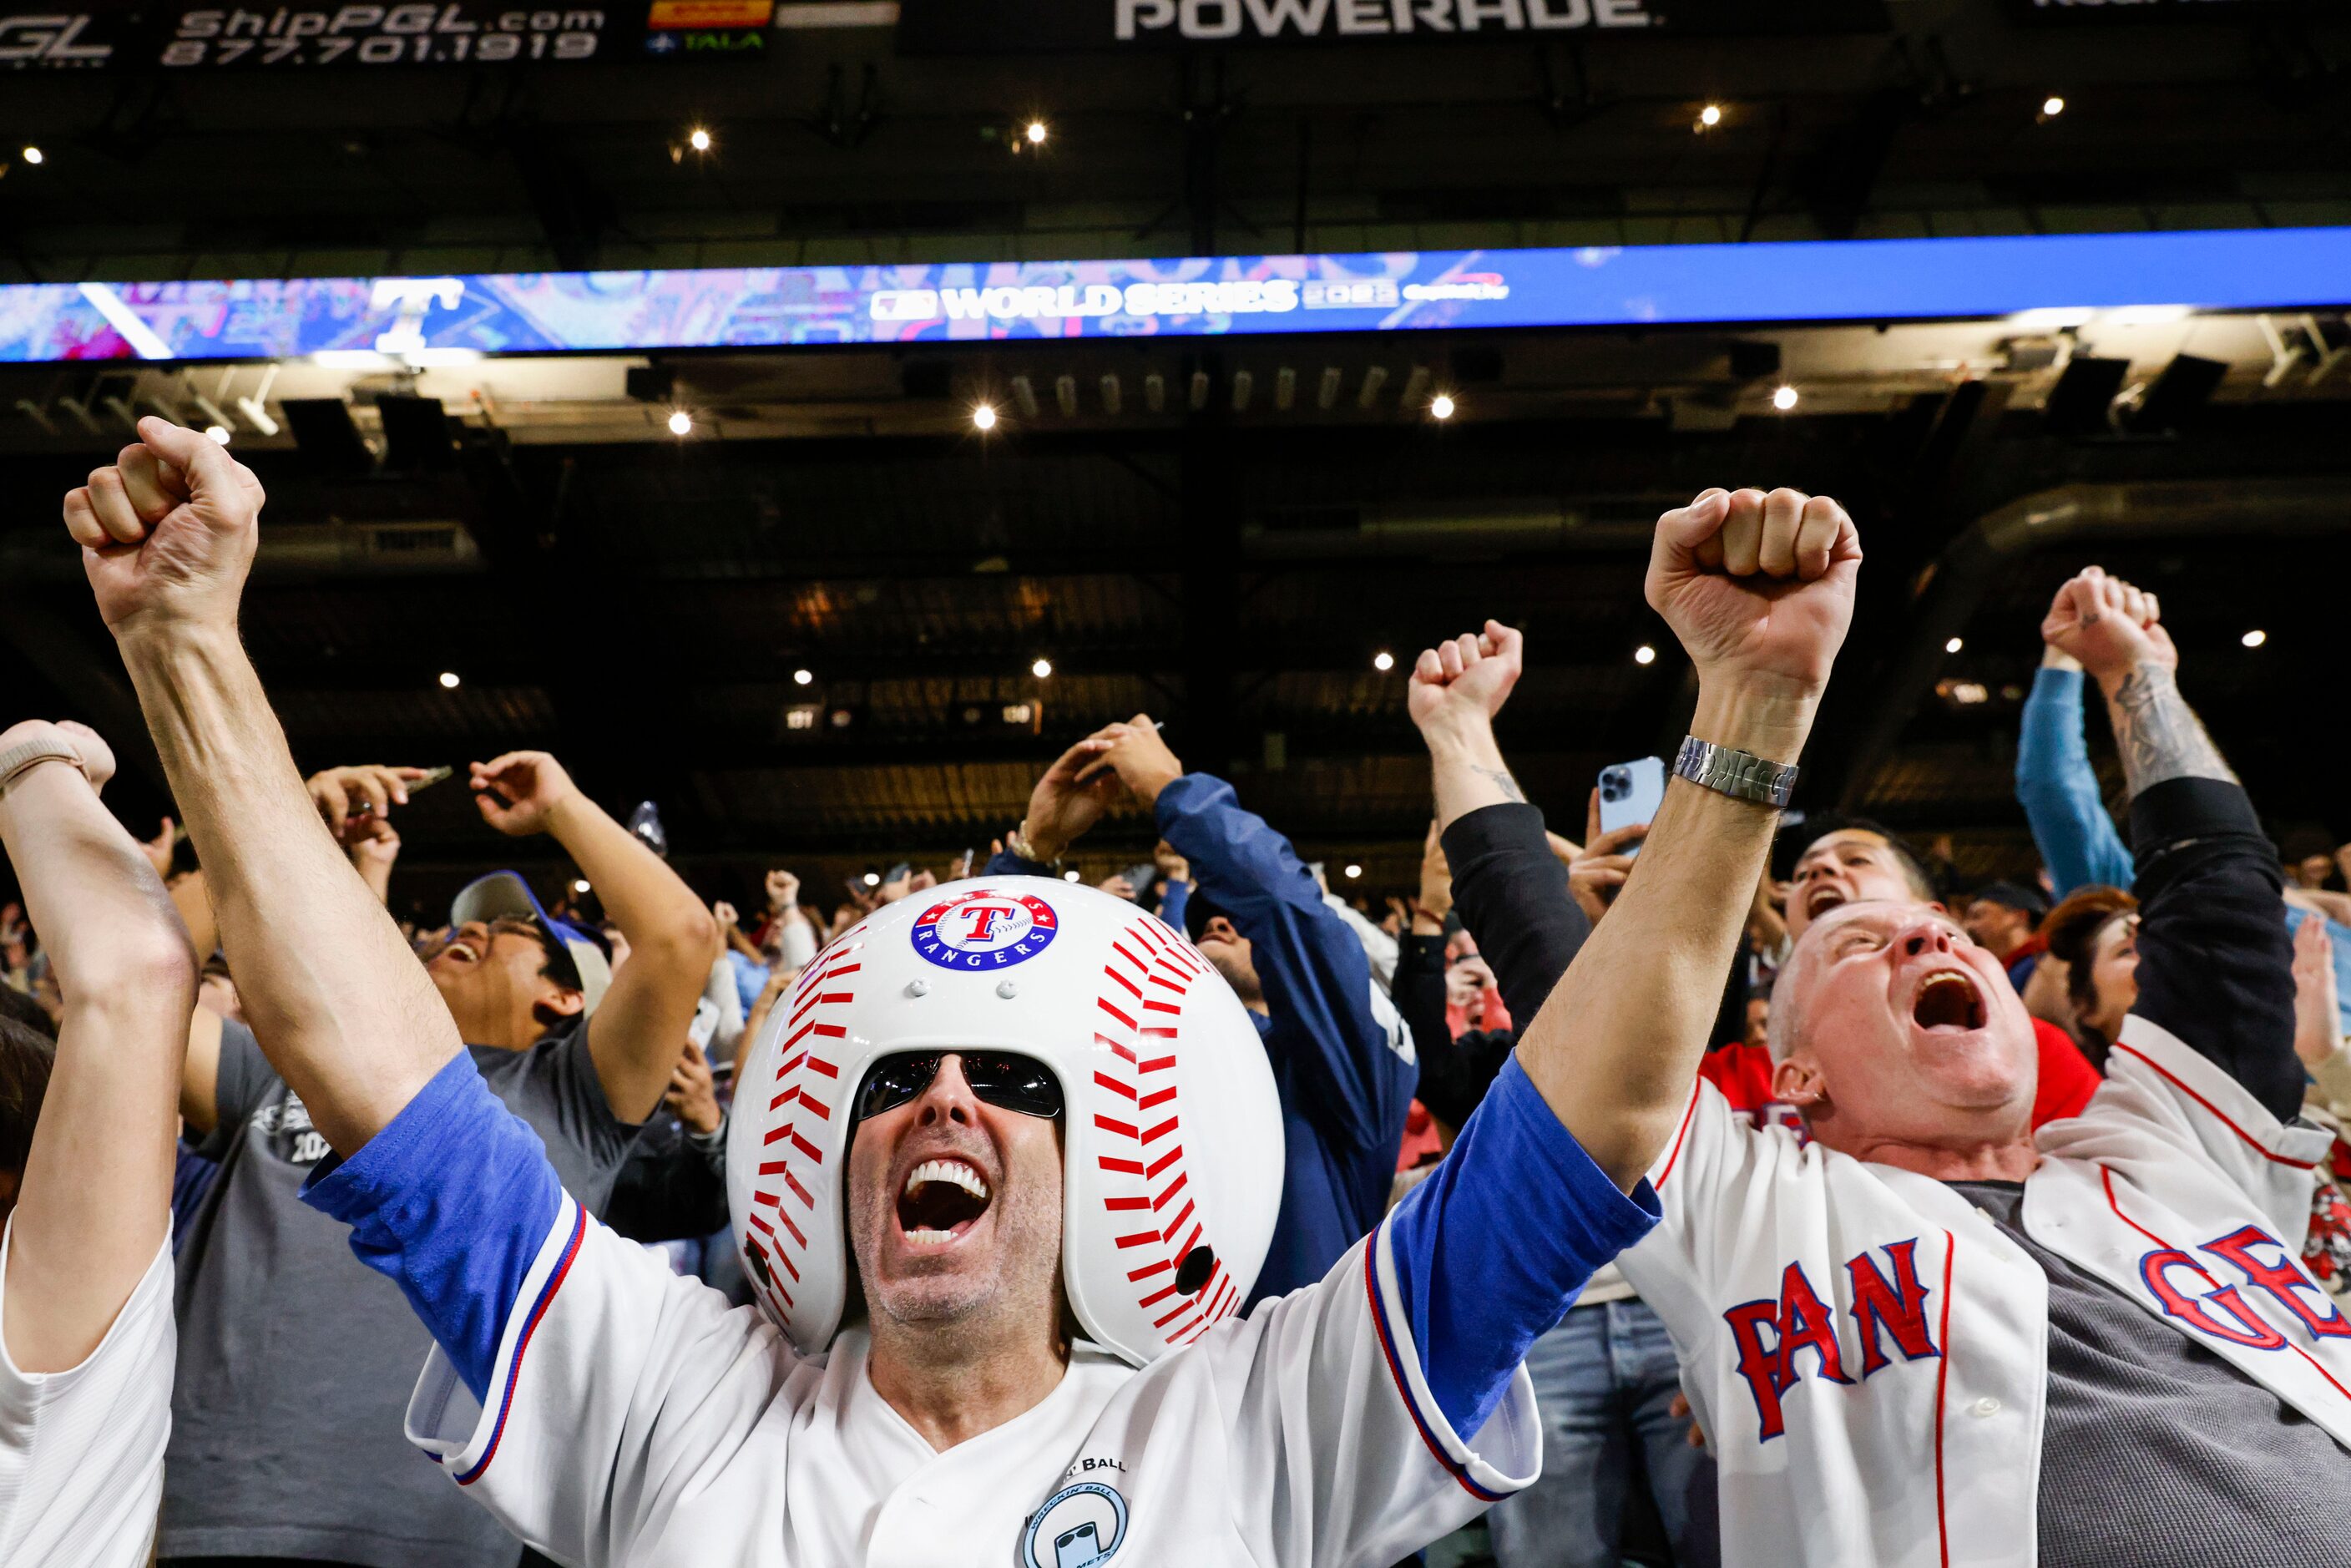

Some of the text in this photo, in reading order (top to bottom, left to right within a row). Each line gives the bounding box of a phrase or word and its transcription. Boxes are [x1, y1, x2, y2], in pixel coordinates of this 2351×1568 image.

[174, 3, 607, 42] ShipPGL.com
[159, 31, 599, 66] 877.701.1919
[941, 285, 1122, 319] WORLD
[1125, 280, 1298, 316] SERIES
[961, 907, 1016, 942] T
[918, 930, 1045, 966] RANGERS
[1084, 1485, 1111, 1497] BALL
